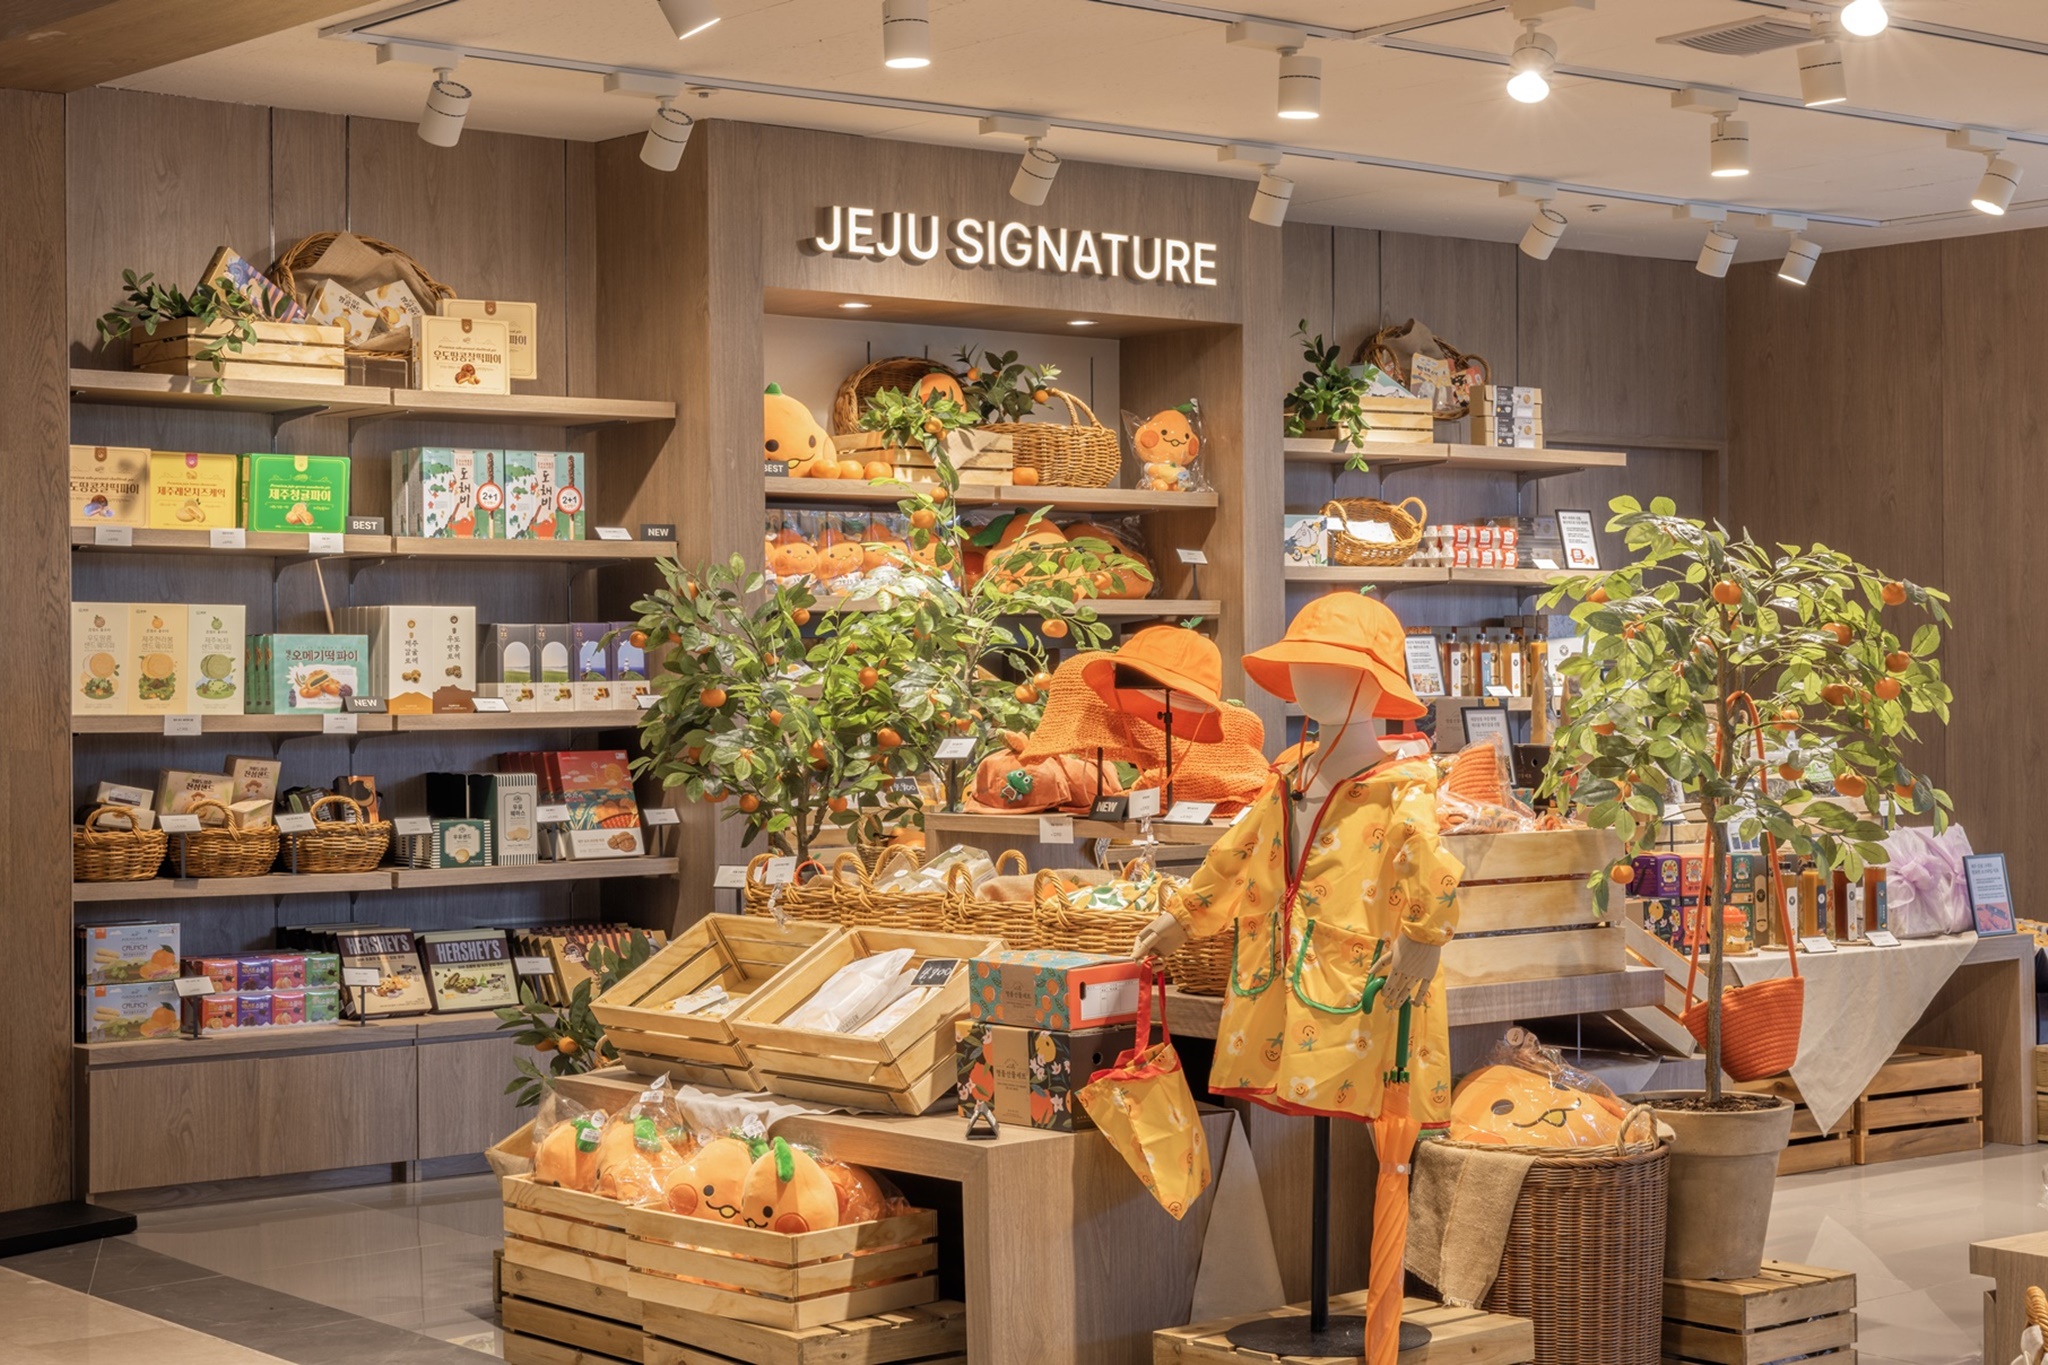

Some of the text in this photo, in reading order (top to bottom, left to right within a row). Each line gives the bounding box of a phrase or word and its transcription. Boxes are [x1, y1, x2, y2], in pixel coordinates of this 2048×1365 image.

[816, 205, 1218, 286] JEJU SIGNATURE
[433, 350, 502, 365] 우도땅콩찰떡파이
[764, 464, 783, 473] BEST
[459, 468, 471, 509] 도채비
[540, 470, 552, 511] 도채비
[268, 488, 331, 502] 제주청귤파이
[482, 491, 498, 501] 2+1
[562, 495, 577, 504] 2+1
[353, 521, 378, 531] BEST
[647, 527, 669, 538] NEW
[354, 698, 378, 708] NEW
[1095, 801, 1118, 813] NEW
[121, 944, 148, 952] CRUNCH
[345, 933, 411, 955] HERSHEY'S
[436, 940, 502, 963] HERSHEY'S
[121, 1002, 148, 1010] CRUNCH
